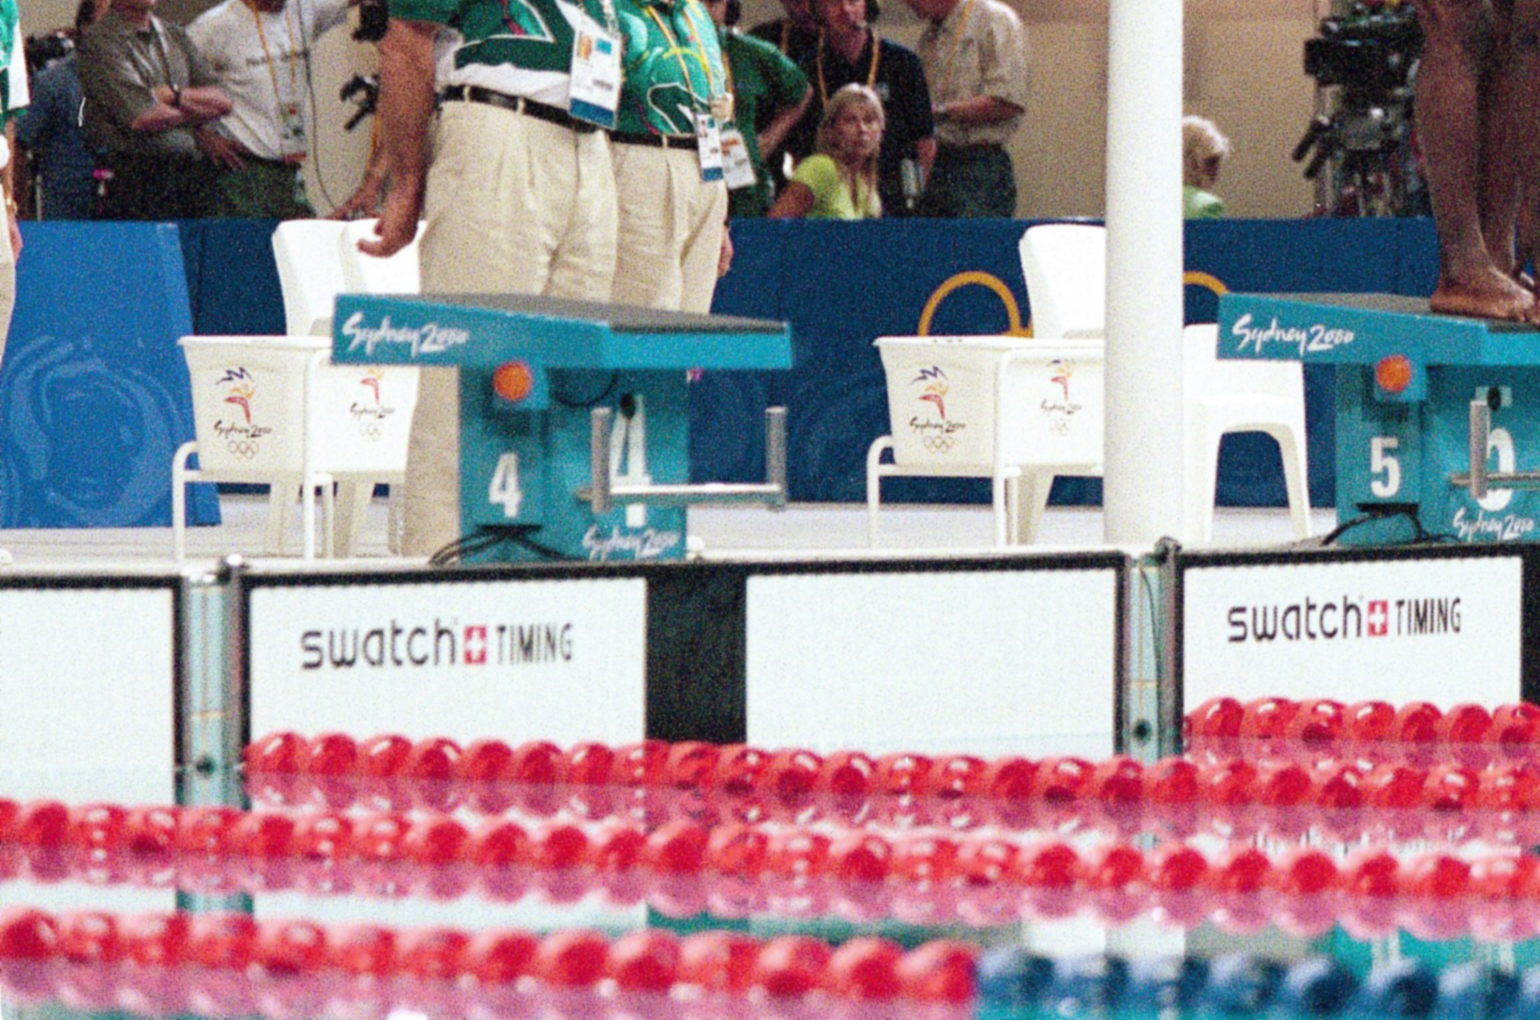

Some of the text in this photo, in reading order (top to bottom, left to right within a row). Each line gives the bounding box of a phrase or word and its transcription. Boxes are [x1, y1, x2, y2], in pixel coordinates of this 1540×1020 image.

[341, 311, 470, 359] Sydney 2000
[1231, 312, 1355, 358] Sydney 2000
[488, 452, 523, 519] 4
[1370, 435, 1401, 499] 5
[582, 523, 642, 562] Sydney
[1452, 506, 1535, 543] Sydney 2000
[1227, 594, 1462, 644] swatch TIMING
[301, 618, 574, 671] swatch TIMING
